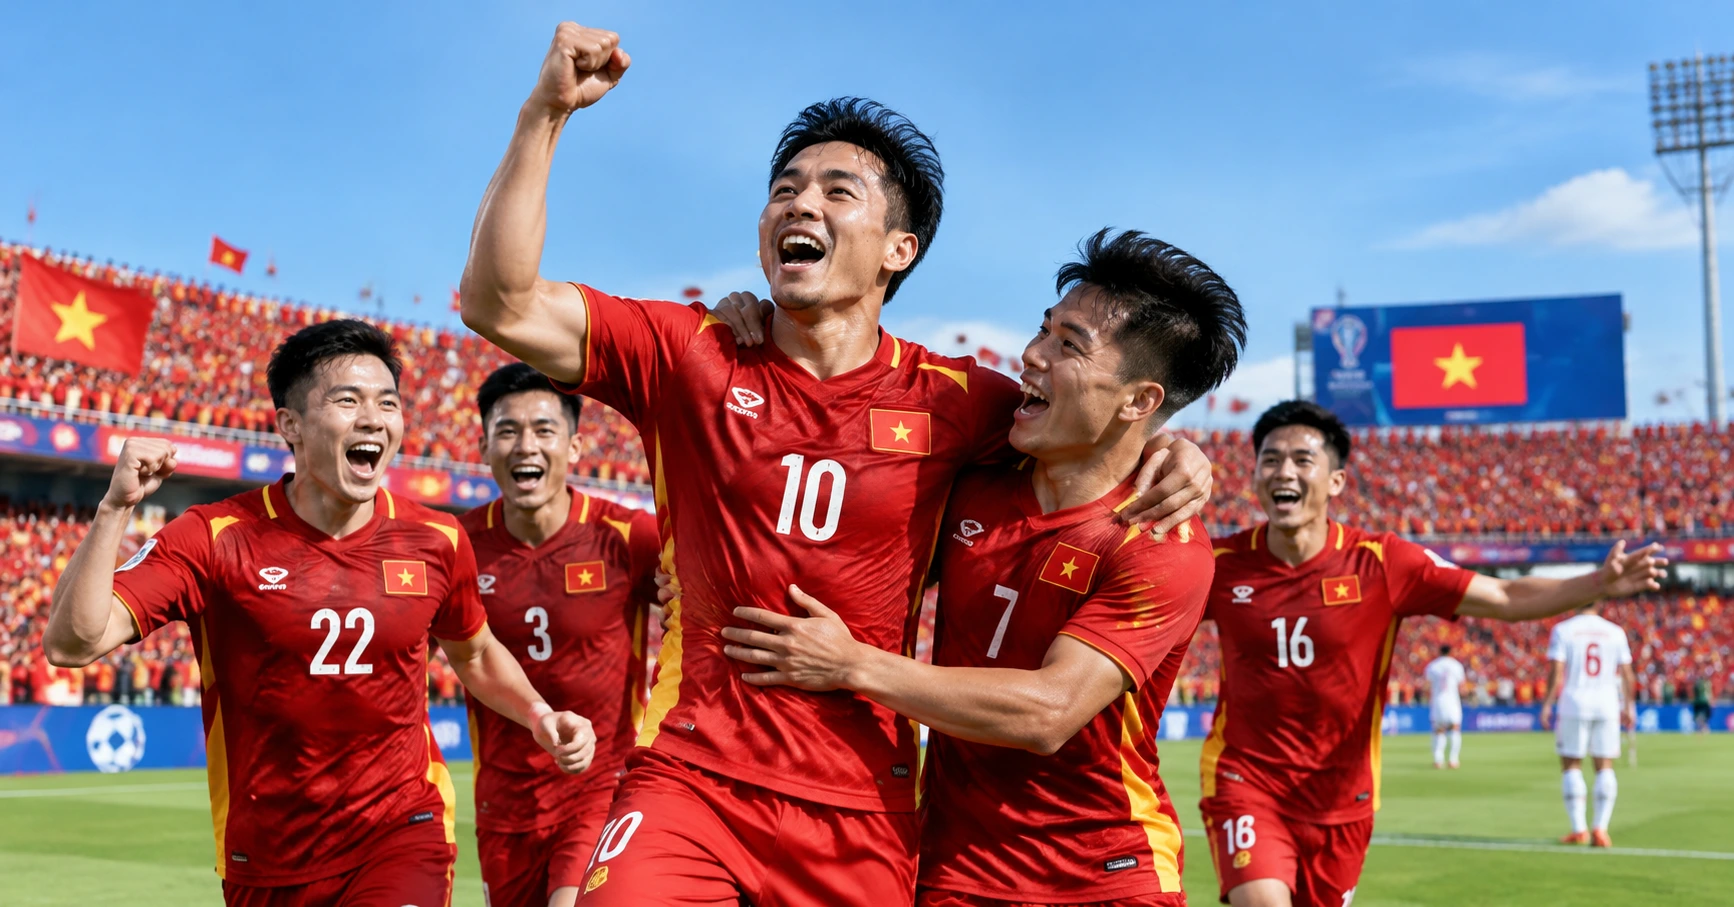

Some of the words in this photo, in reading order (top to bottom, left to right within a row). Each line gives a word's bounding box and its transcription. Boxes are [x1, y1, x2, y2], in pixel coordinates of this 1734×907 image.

[776, 453, 847, 541] 10
[310, 607, 375, 675] 22
[525, 606, 553, 662] 3
[986, 584, 1019, 659] 7
[1271, 616, 1315, 668] 16
[1585, 642, 1602, 677] 6
